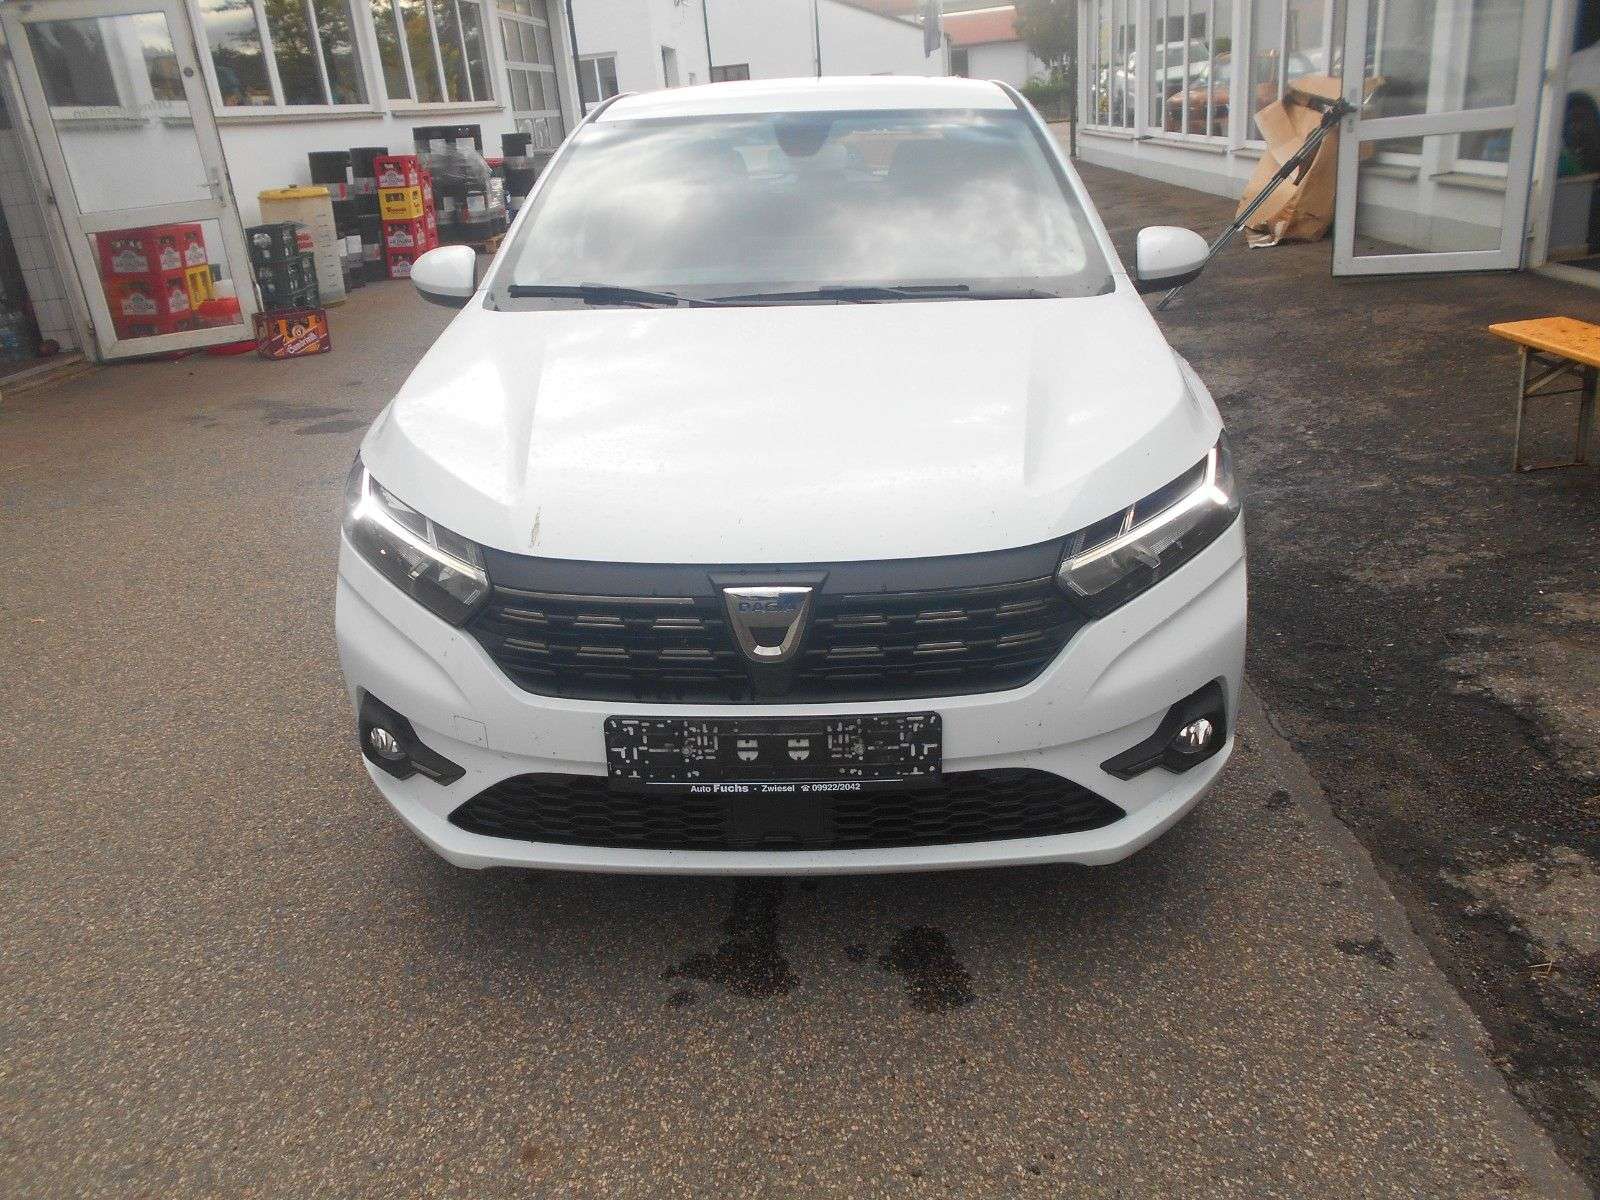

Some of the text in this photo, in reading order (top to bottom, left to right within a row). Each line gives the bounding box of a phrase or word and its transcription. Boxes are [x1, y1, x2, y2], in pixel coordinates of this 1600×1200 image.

[690, 783, 861, 793] Auto Fuchs Zwiesel 09922/2042
